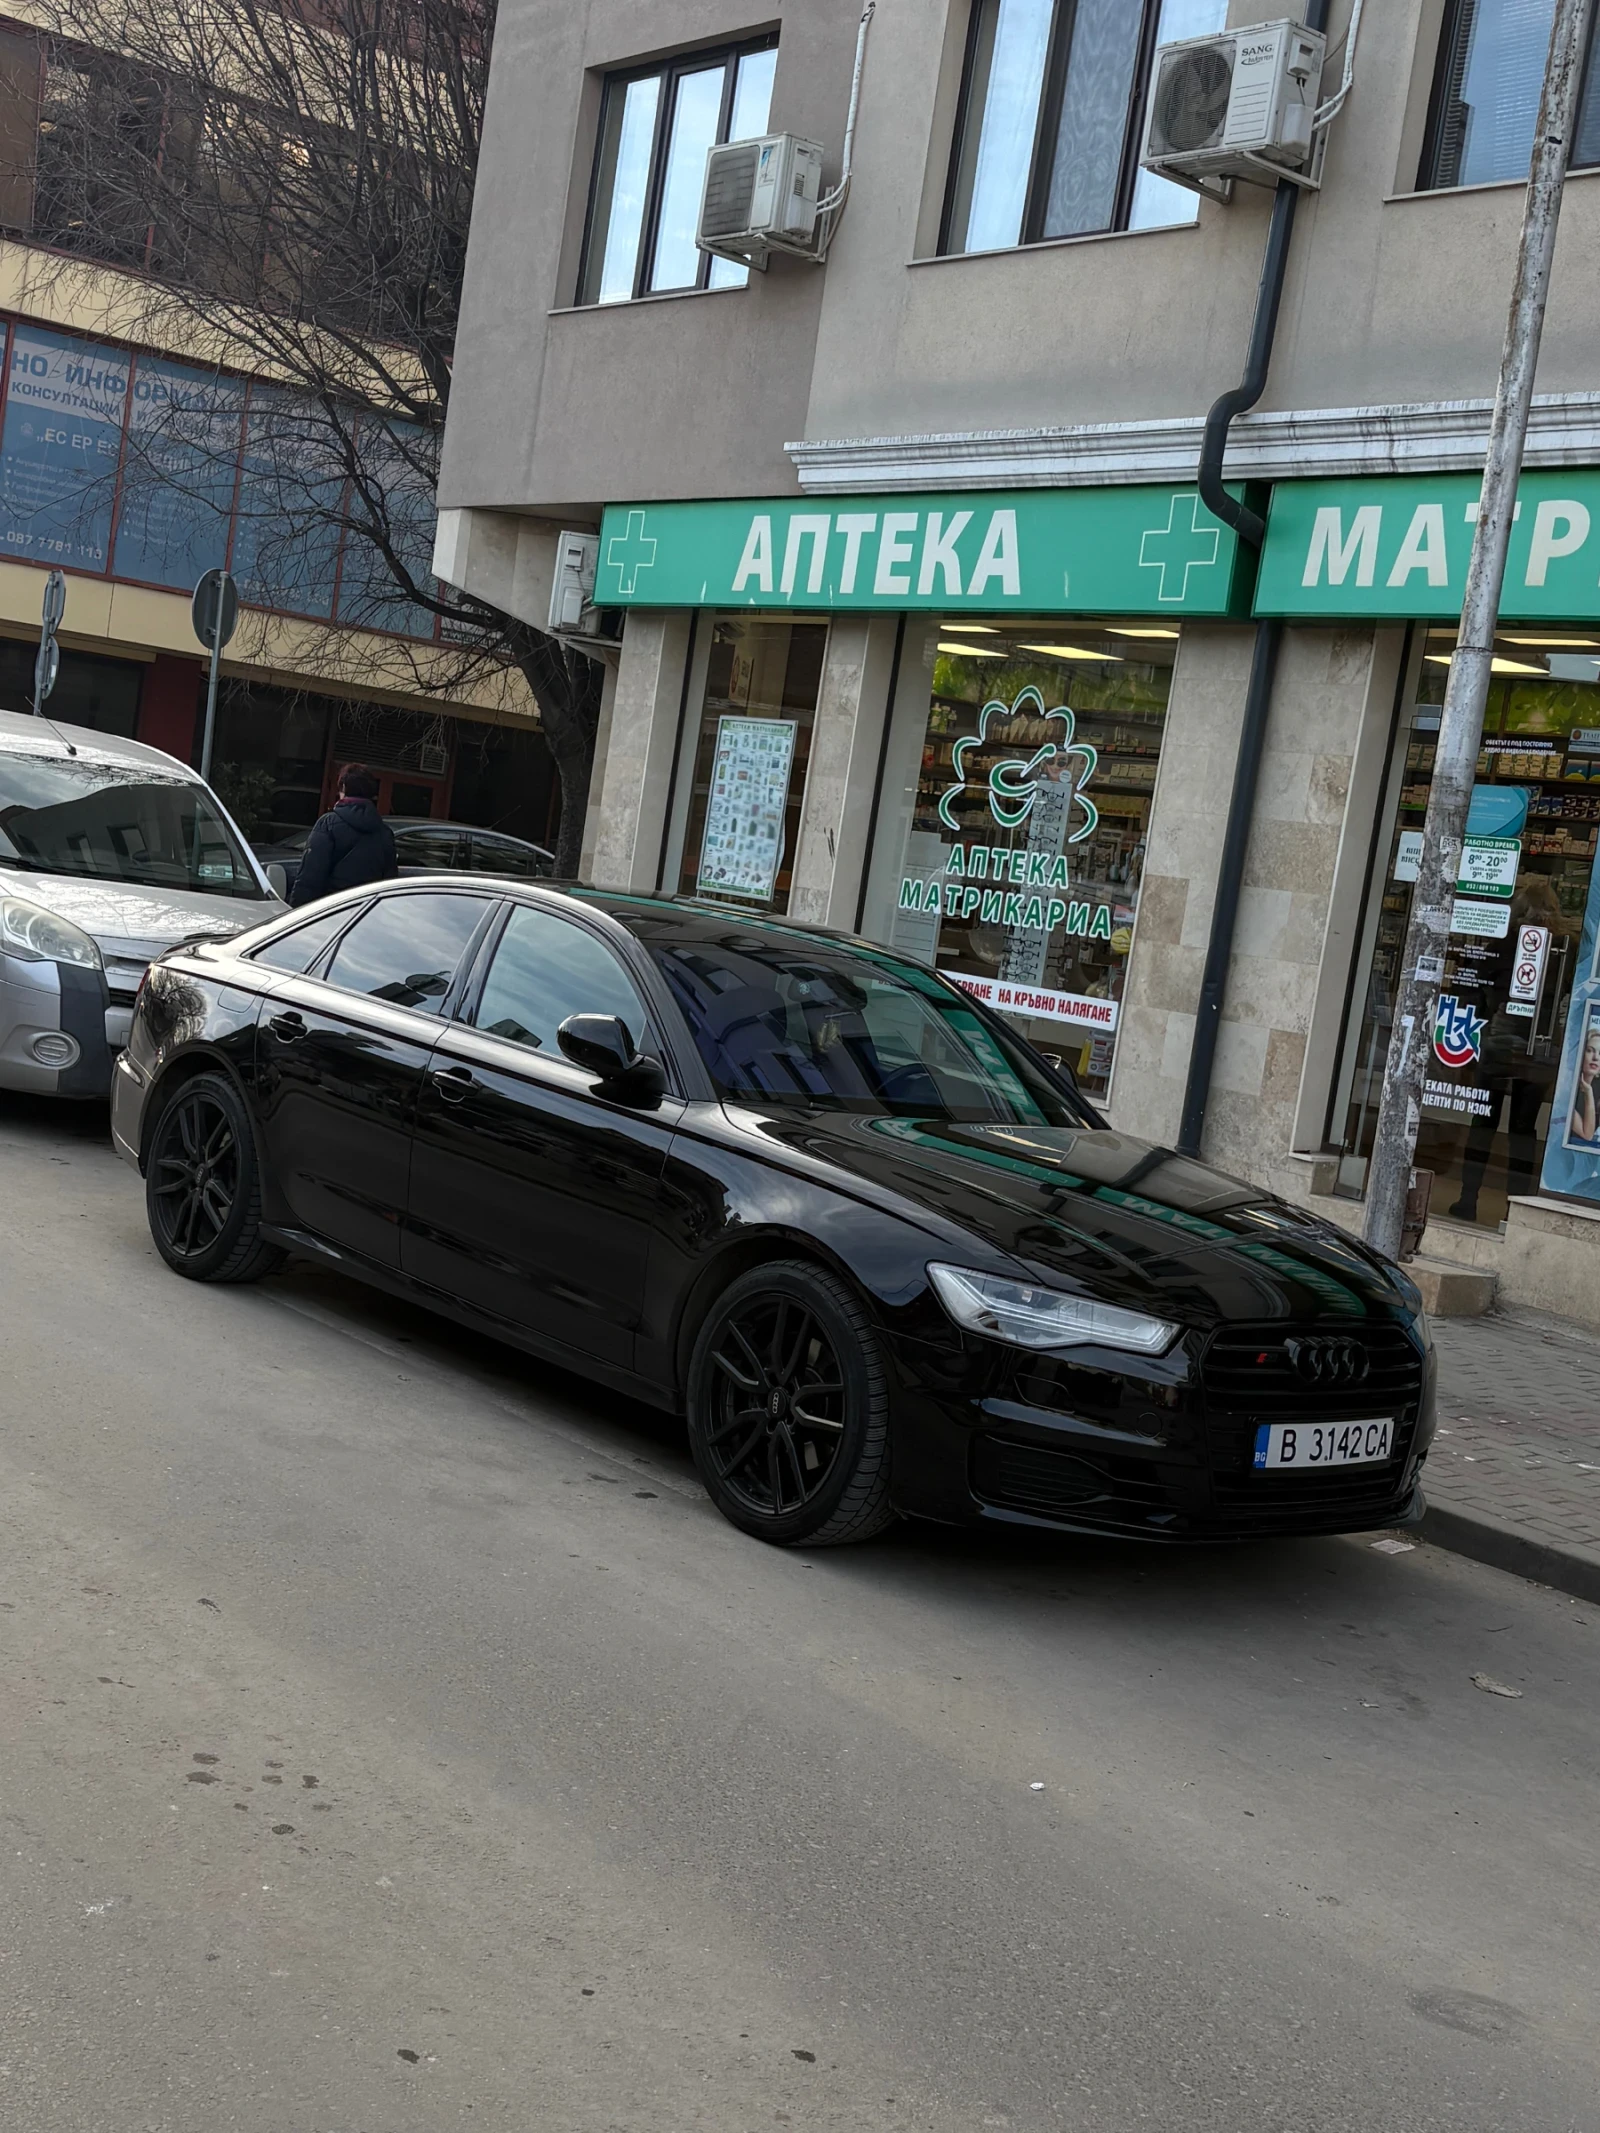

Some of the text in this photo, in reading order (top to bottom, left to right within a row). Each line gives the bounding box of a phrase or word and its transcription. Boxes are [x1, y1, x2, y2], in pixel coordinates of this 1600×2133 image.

[1241, 44, 1273, 57] SANG
[6, 531, 33, 545] 087
[731, 510, 1021, 596] АПТЕКА
[1464, 839, 1516, 850] РАБОТНО ВРЕМЕ
[945, 843, 1070, 890] АПТЕКА
[899, 877, 1111, 940] МАТРИКАРИА
[997, 988, 1011, 1004] НА
[1013, 991, 1056, 1012] КРЪВНО
[1057, 997, 1113, 1023] НАЛЯГАНЕ
[1454, 1084, 1490, 1102] РАБОТИ
[1452, 1098, 1466, 1112] ПО
[1467, 1101, 1493, 1117] НЗОК
[1279, 1429, 1297, 1463] B
[1254, 1451, 1267, 1462] BG
